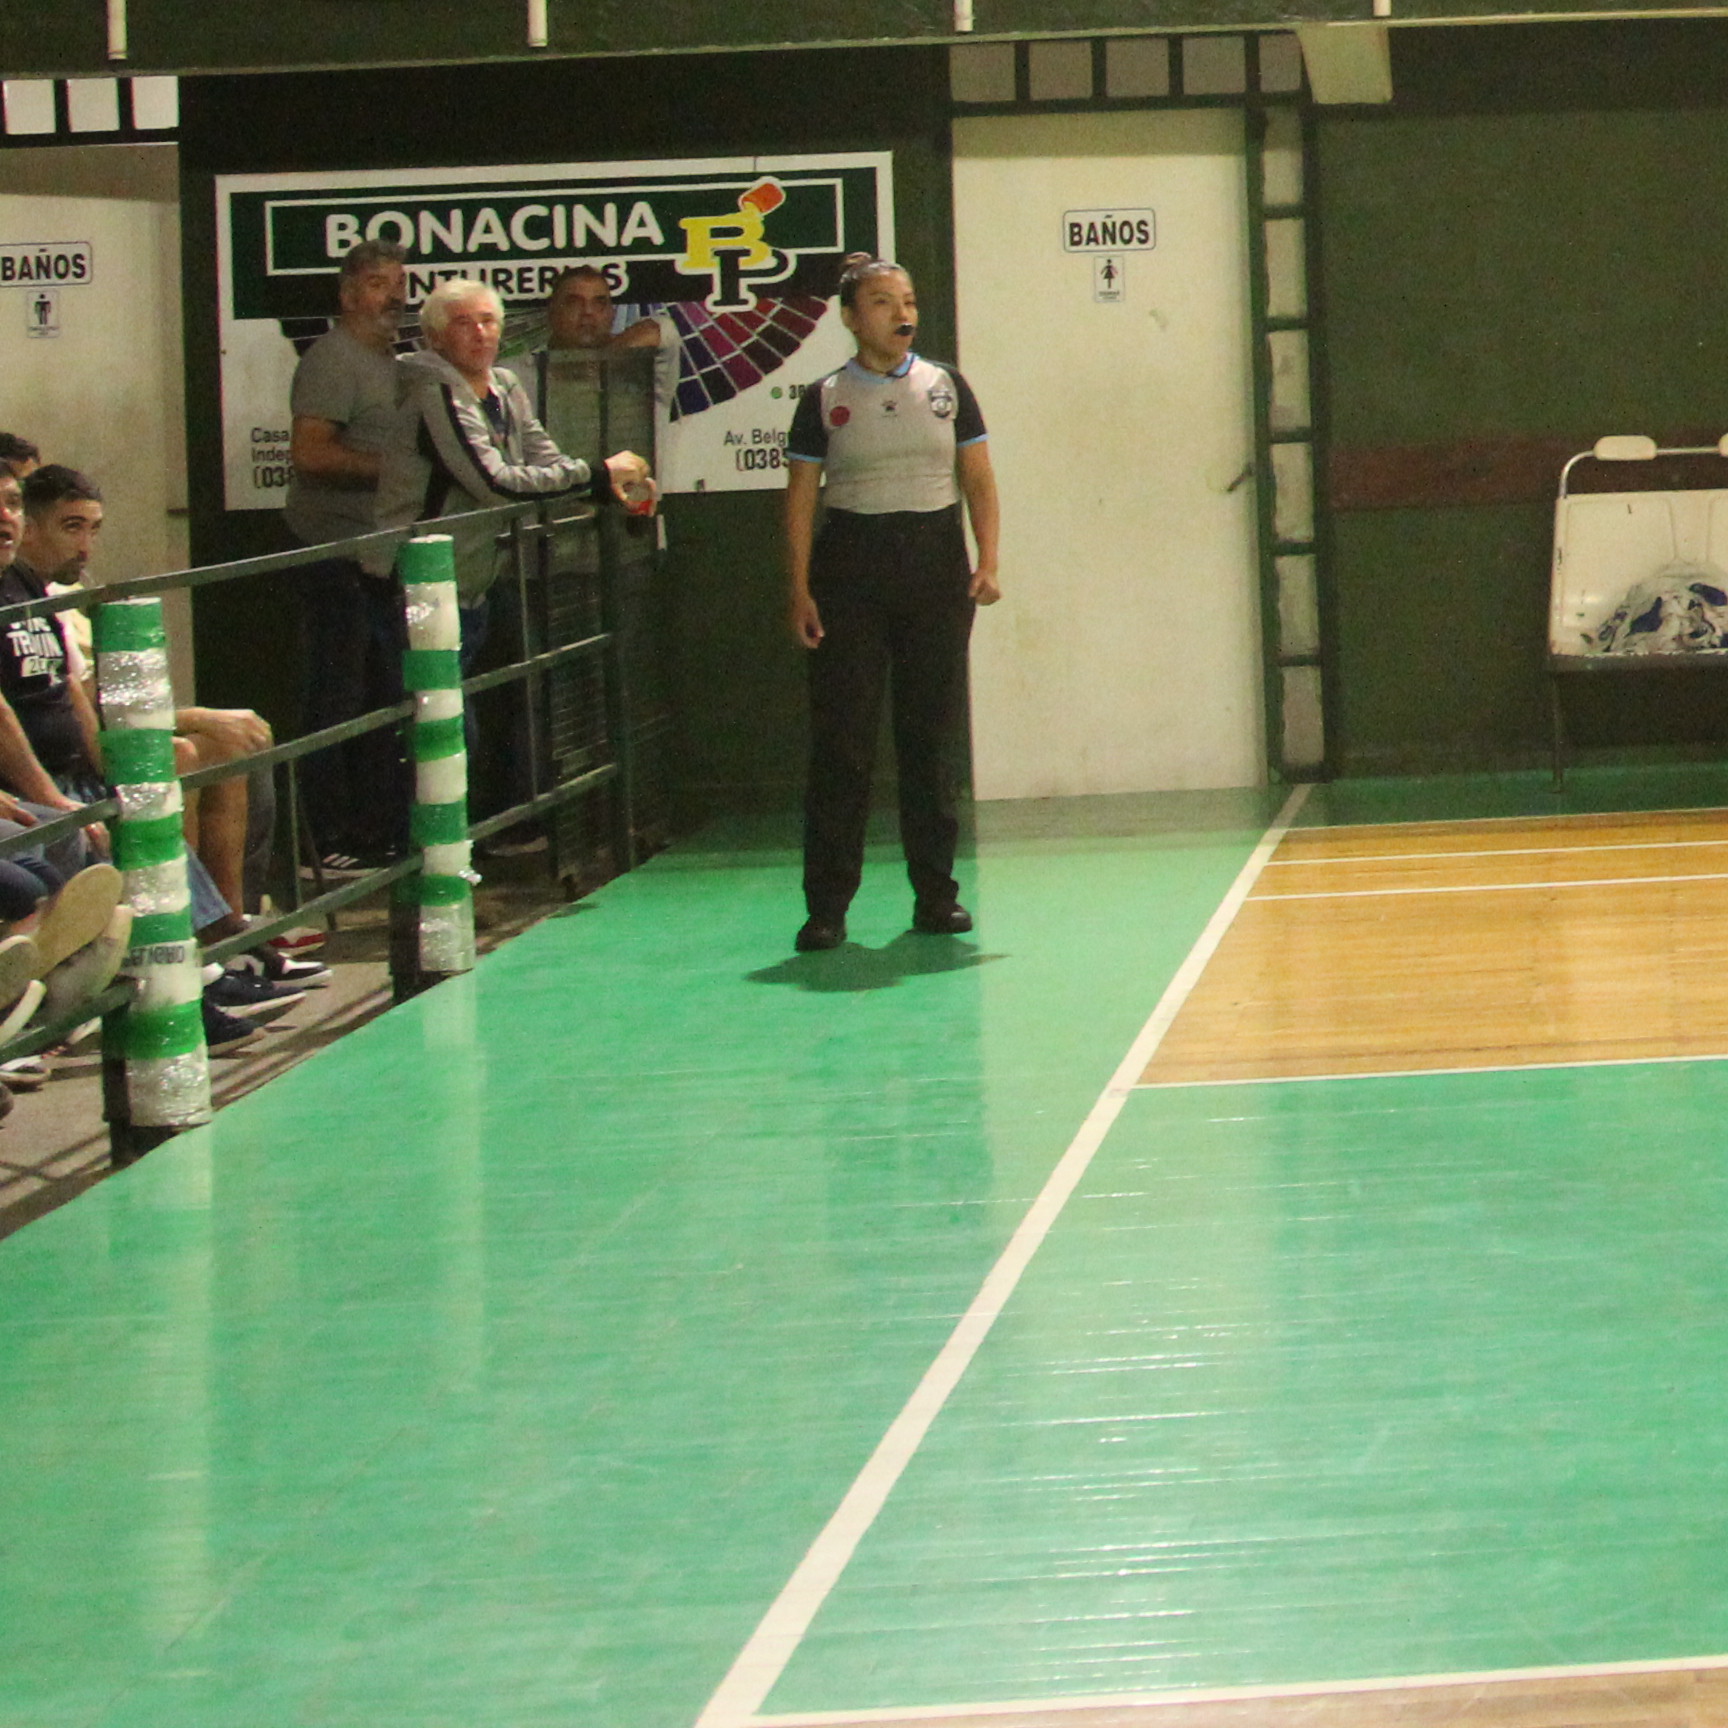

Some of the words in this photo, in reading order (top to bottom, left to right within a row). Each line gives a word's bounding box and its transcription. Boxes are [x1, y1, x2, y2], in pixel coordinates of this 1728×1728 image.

[325, 201, 665, 259] BONACINA
[1069, 214, 1150, 247] BAÑOS
[1, 248, 87, 281] BAÑOS
[251, 427, 290, 443] Casa
[724, 431, 748, 446] Av.
[752, 428, 789, 448] Belg
